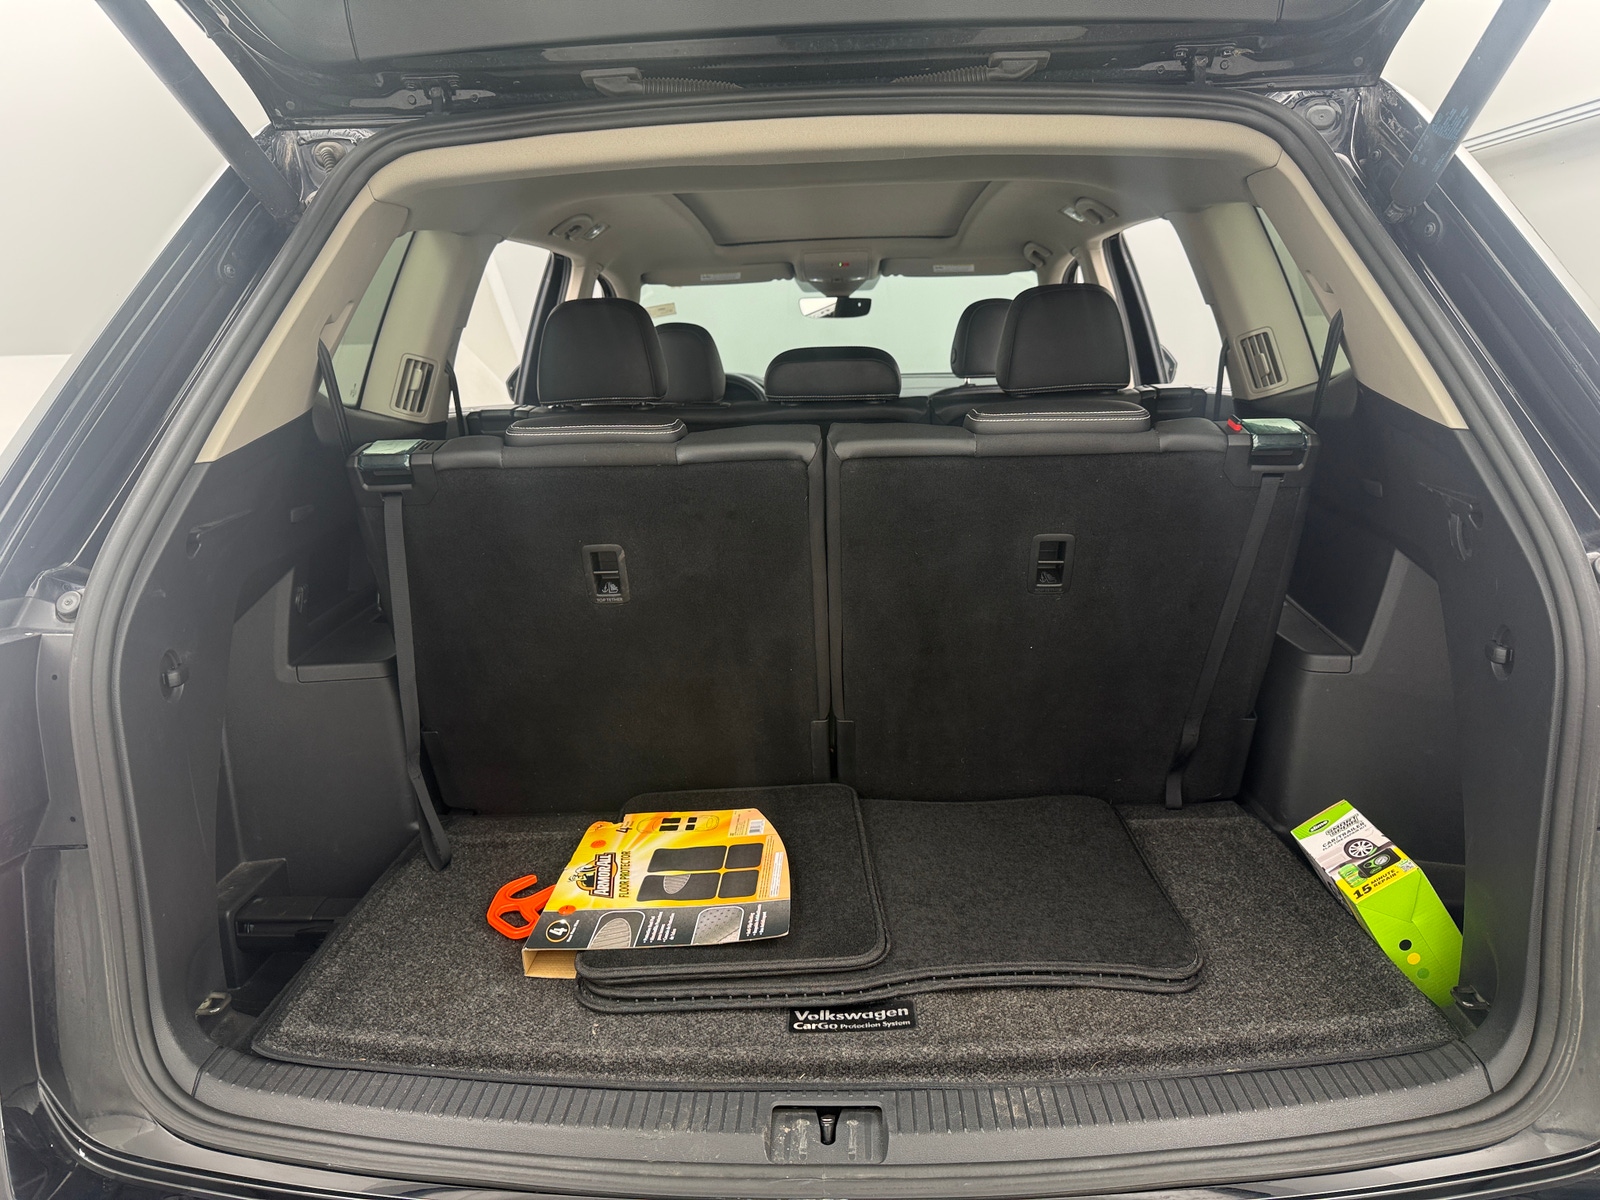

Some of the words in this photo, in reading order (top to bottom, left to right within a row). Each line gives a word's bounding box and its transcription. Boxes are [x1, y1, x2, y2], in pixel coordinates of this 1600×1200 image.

[616, 825, 632, 834] 4
[619, 850, 631, 880] PROTECTOR
[1370, 868, 1395, 885] MINUTE
[618, 881, 630, 898] FLOOR
[1353, 884, 1373, 899] 15
[549, 925, 568, 936] 4
[794, 1008, 909, 1021] Volkswagen
[793, 1021, 838, 1030] CarGo
[840, 1021, 881, 1030] Protection
[882, 1020, 911, 1028] System
